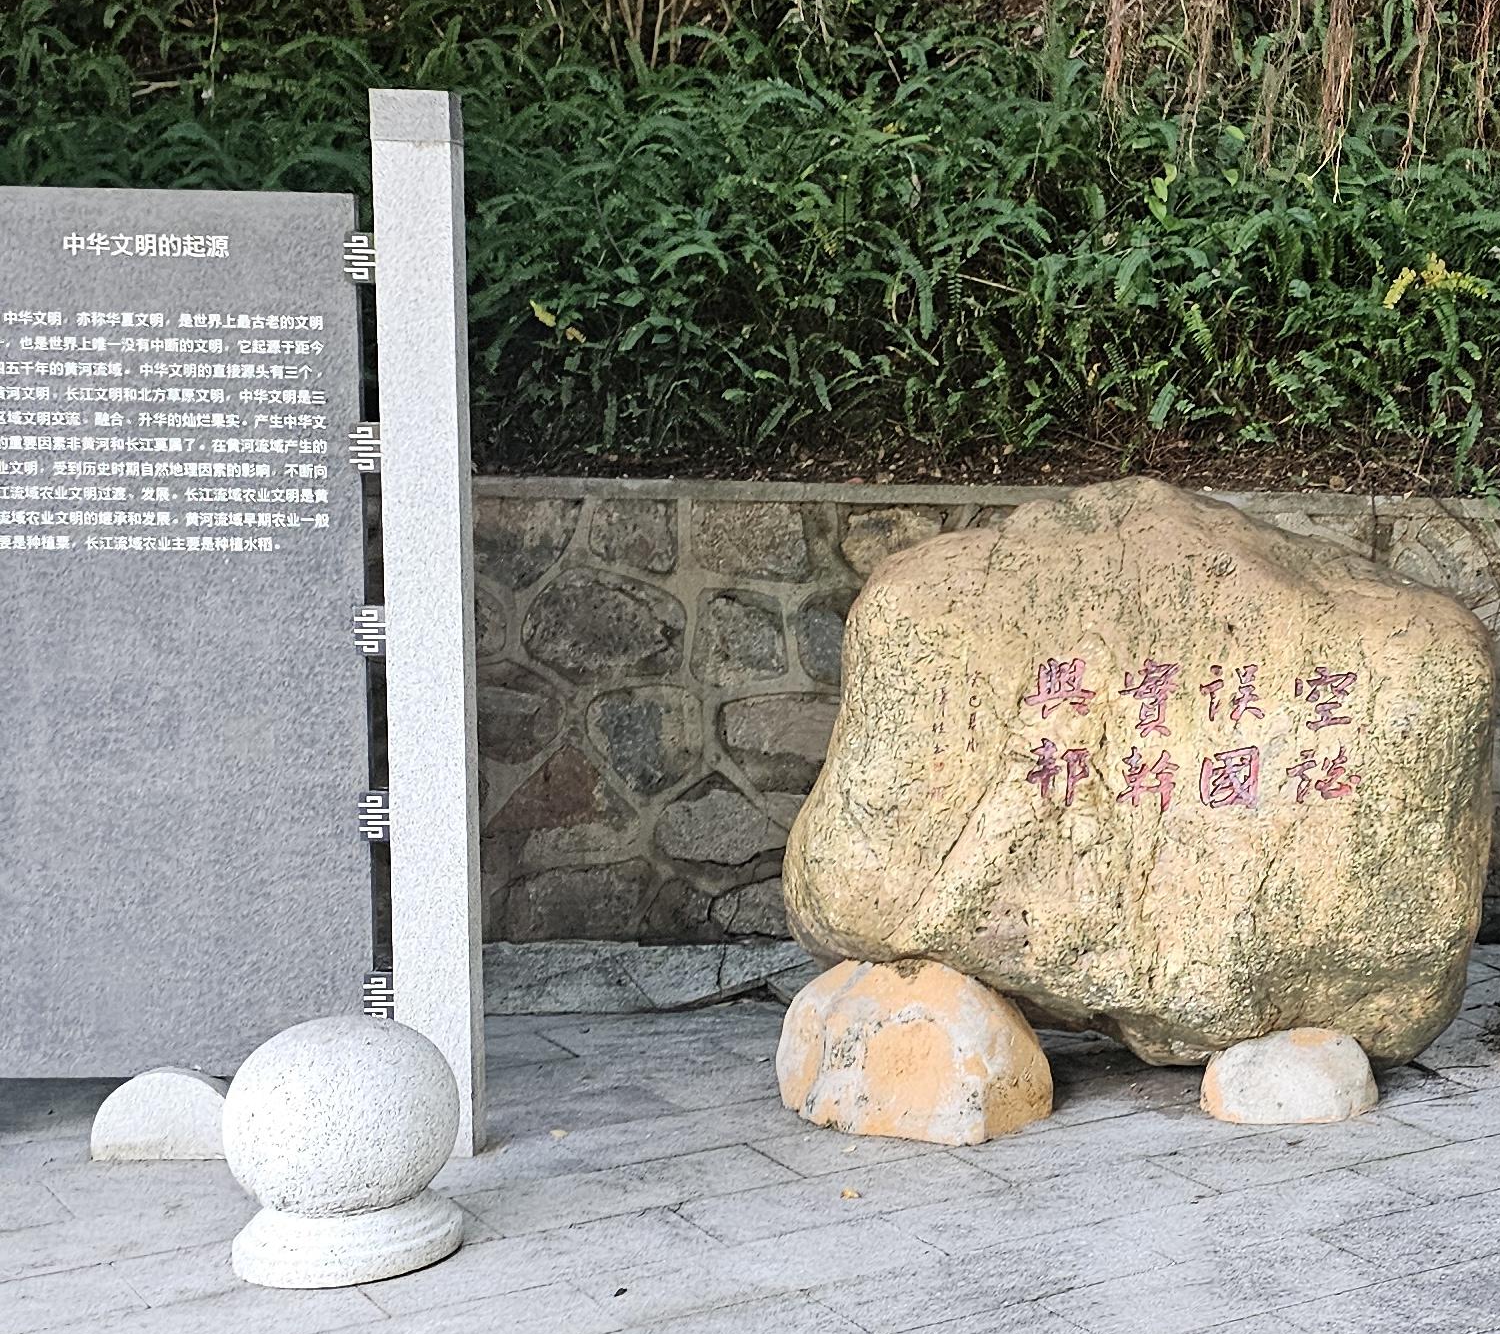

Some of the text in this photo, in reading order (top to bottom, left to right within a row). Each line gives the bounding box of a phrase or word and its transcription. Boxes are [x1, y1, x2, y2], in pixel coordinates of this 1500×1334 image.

[63, 232, 230, 258] 中华文明的起源
